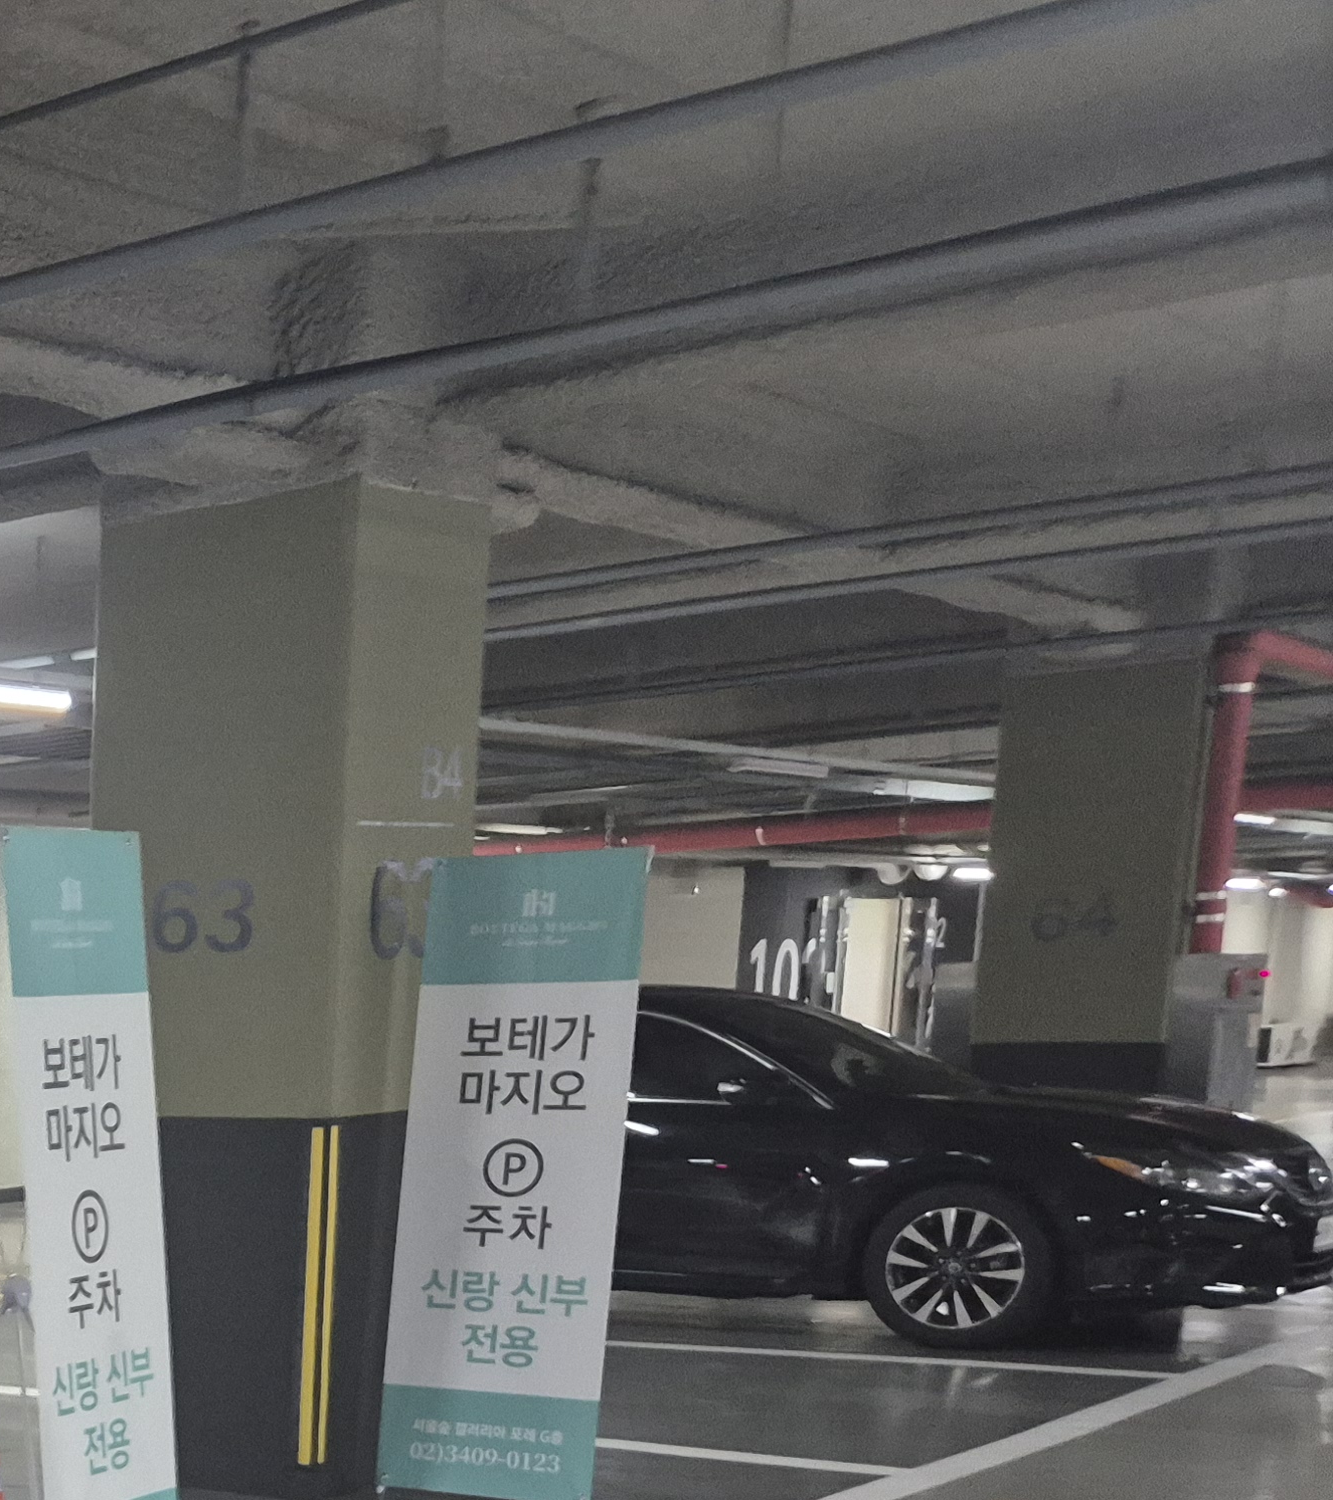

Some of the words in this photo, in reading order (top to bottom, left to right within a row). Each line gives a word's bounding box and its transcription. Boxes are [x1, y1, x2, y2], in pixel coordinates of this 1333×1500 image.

[152, 878, 255, 954] 63
[42, 1034, 121, 1091] 보테가
[460, 1014, 595, 1061] 보테가
[459, 1069, 587, 1115] 마지오
[46, 1102, 125, 1162] 마지오
[463, 1205, 552, 1250] 주차
[68, 1269, 122, 1329] 주차
[421, 1269, 501, 1312] 신랑
[510, 1273, 589, 1317] 신부
[462, 1324, 538, 1368] 전용
[53, 1358, 99, 1417] 신랑
[106, 1347, 155, 1404] 신부
[83, 1418, 131, 1476] 전용
[409, 1441, 562, 1474] 02)3409-0123
